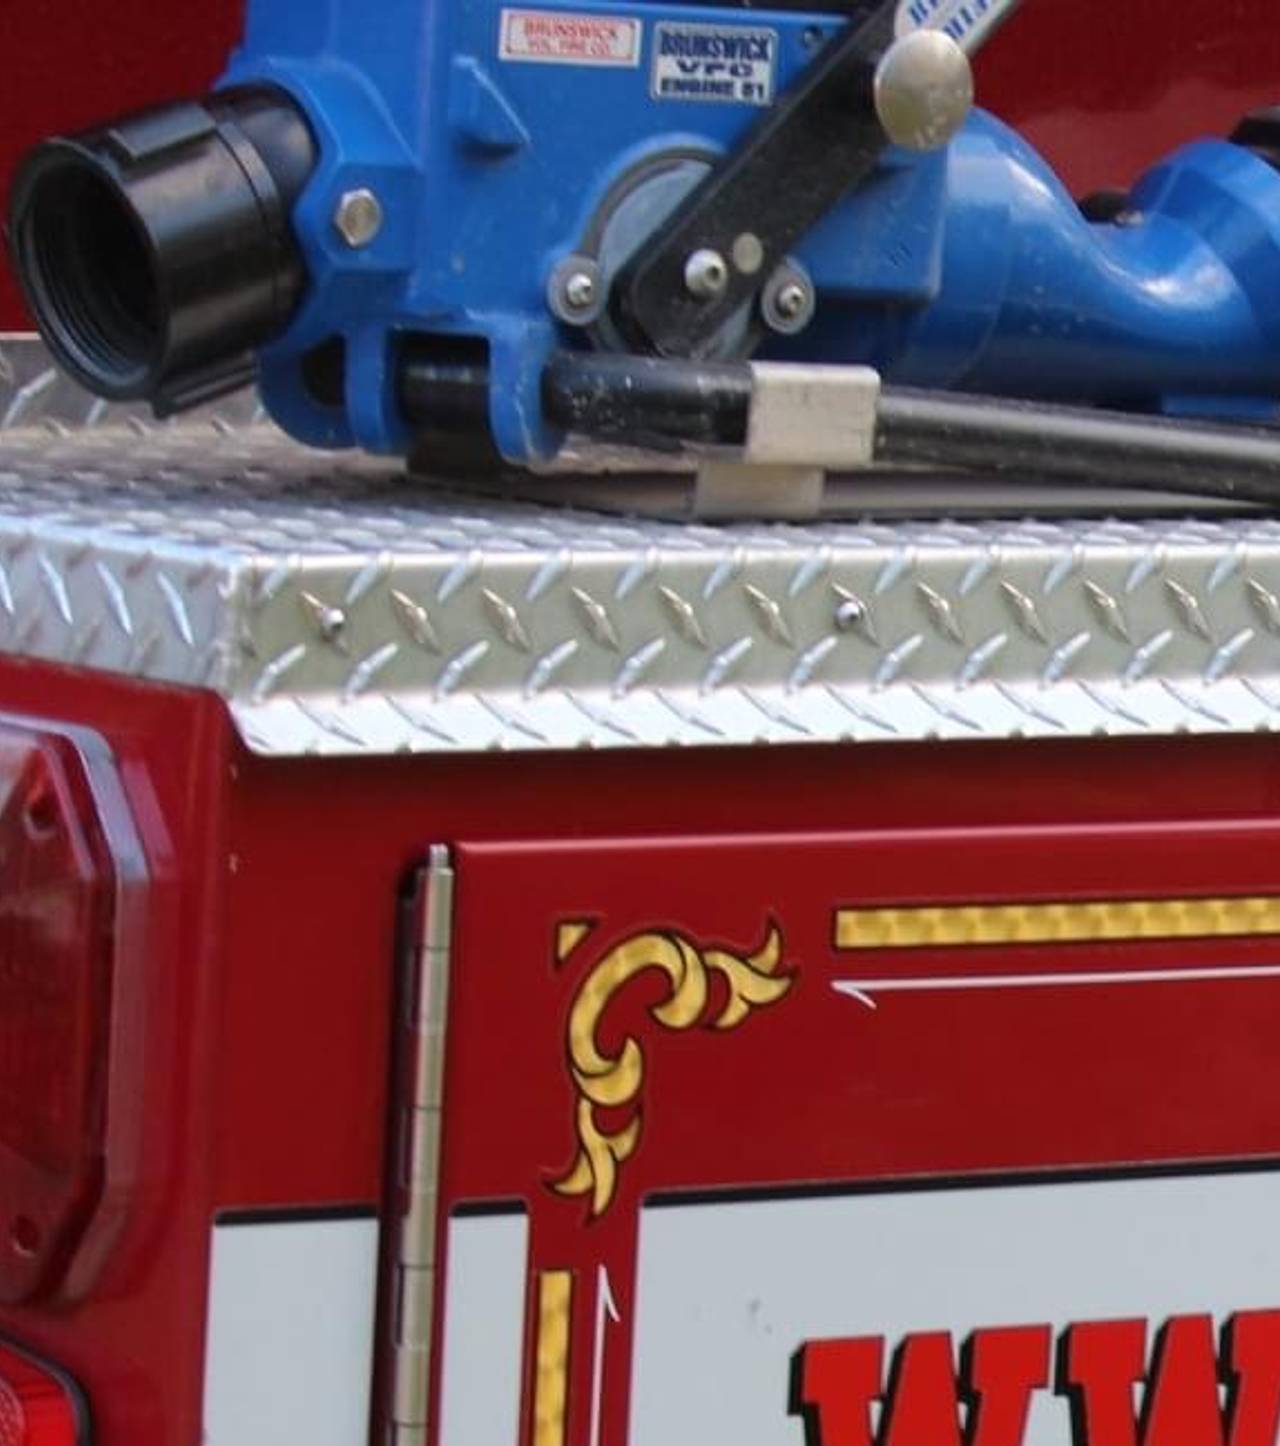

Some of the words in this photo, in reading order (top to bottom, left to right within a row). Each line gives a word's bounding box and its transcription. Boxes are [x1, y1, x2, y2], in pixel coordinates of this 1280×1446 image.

[524, 19, 617, 39] BRUNSWICK
[660, 32, 769, 62] BRUNSWICK
[660, 77, 735, 98] ENGINE
